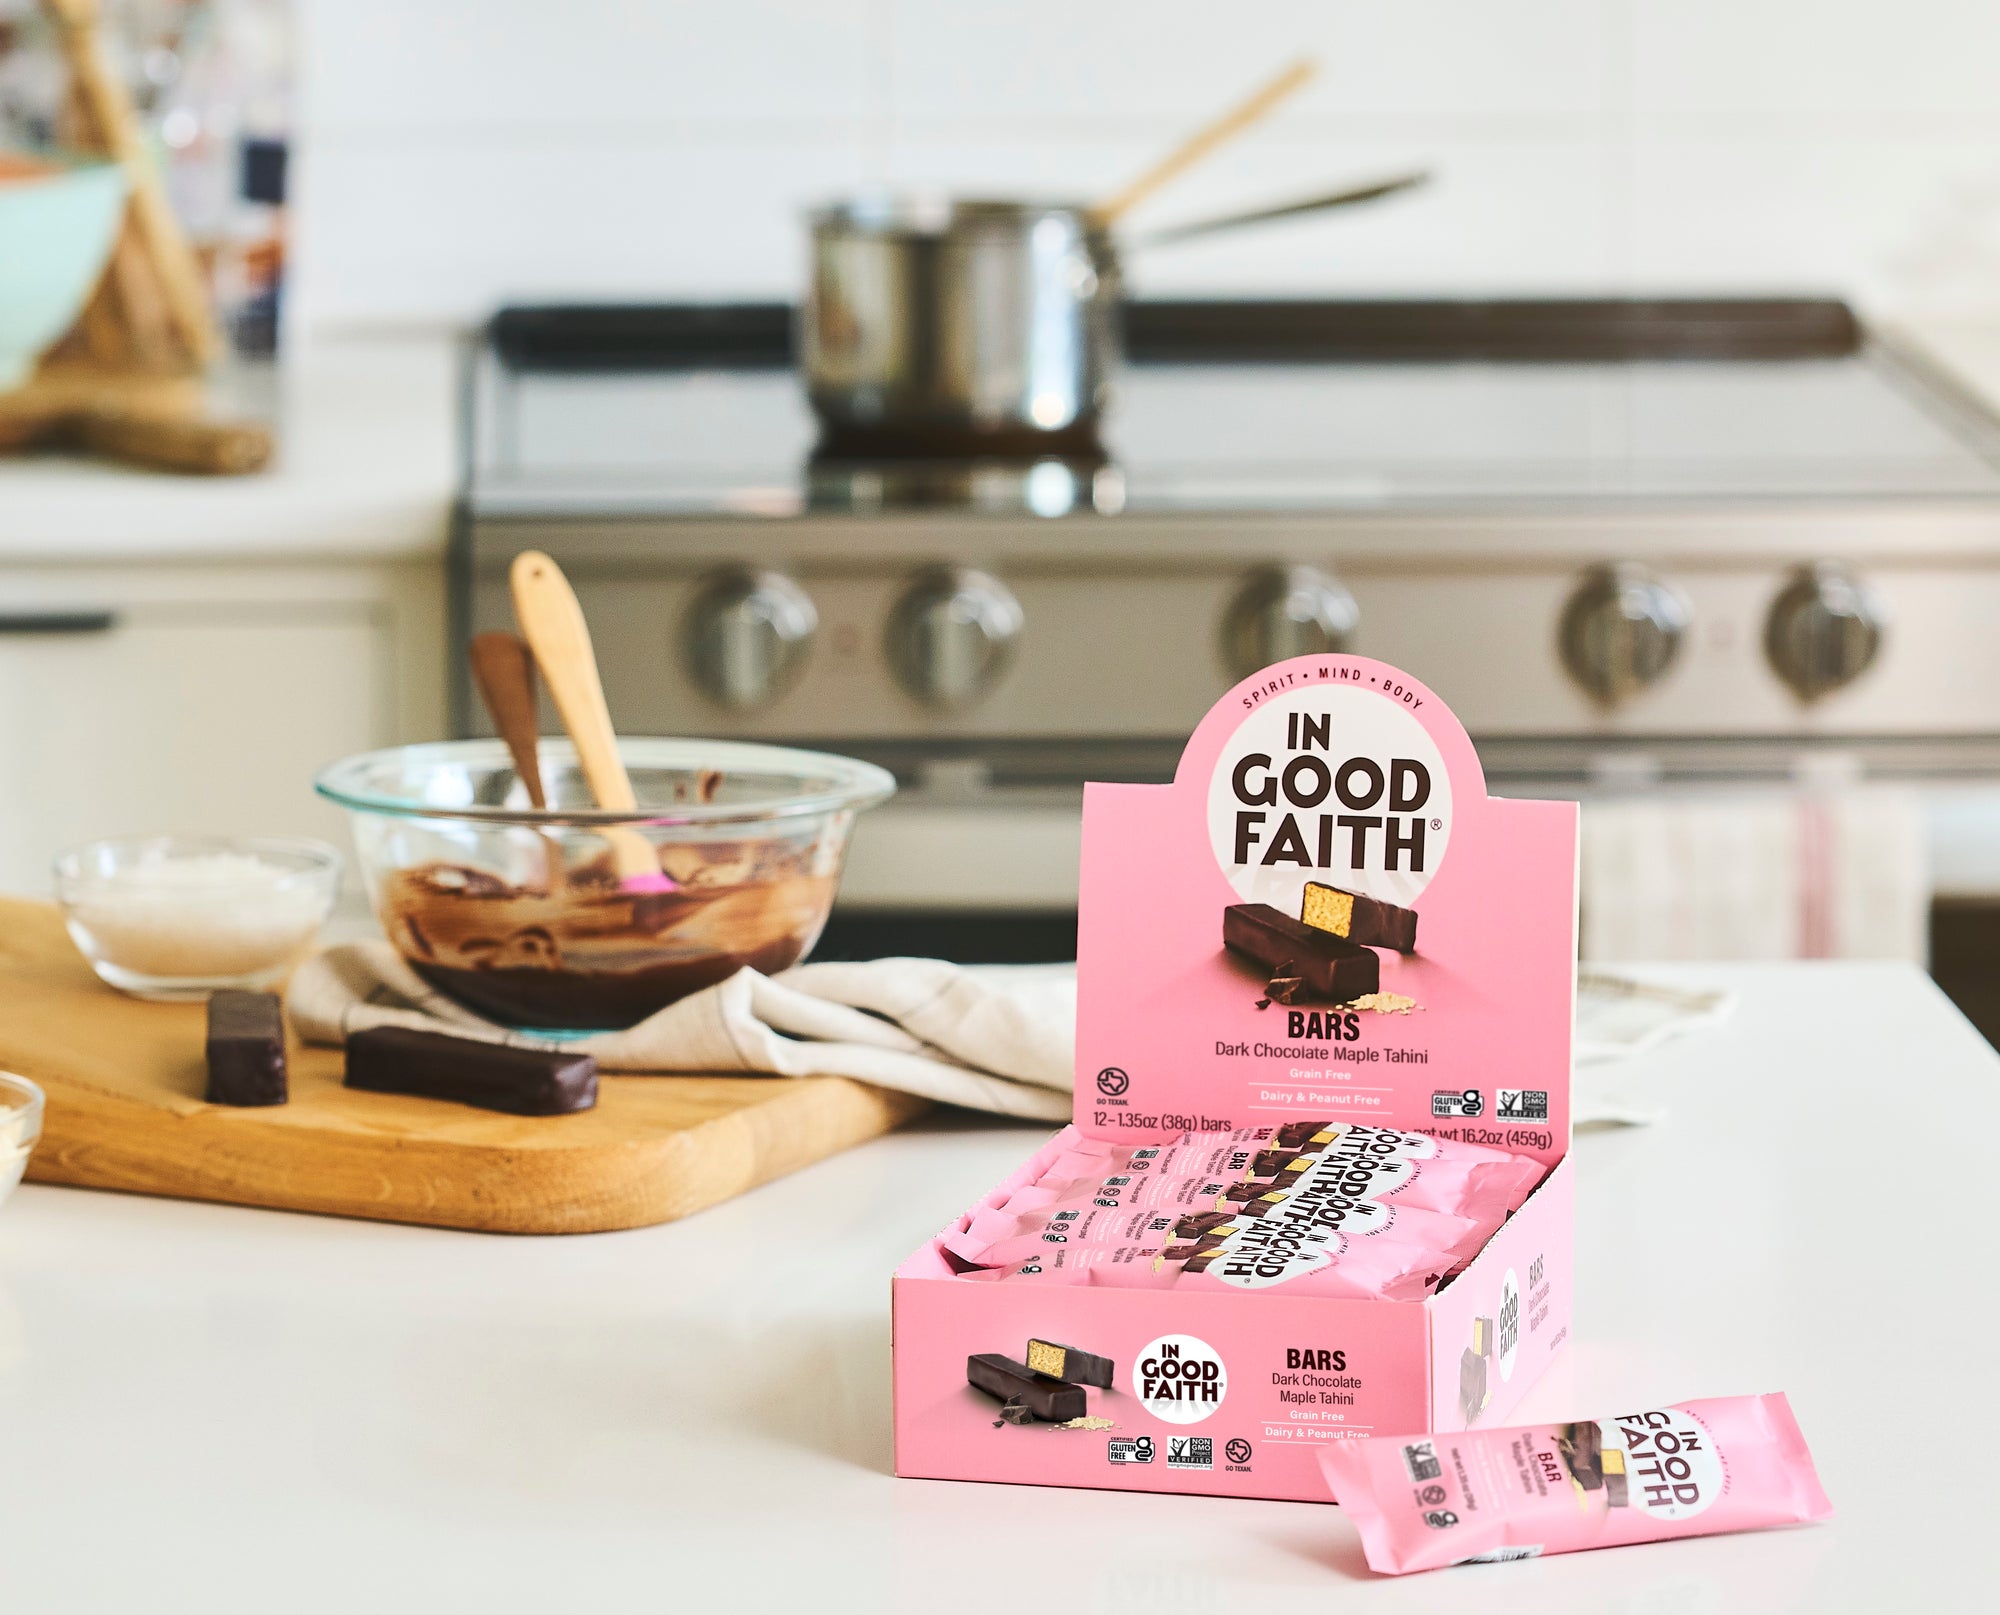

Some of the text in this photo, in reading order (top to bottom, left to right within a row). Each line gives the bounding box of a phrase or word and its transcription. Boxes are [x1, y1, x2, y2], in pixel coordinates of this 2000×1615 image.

[1243, 667, 1423, 710] SPIRIT MIND BODY
[1287, 712, 1331, 751] IN
[1232, 753, 1431, 812] GOOD
[1288, 1011, 1360, 1041] BARS
[1215, 1041, 1428, 1065] Dark Chocolate Maple Tahini
[1289, 1068, 1351, 1081] Grain Free
[1260, 1090, 1381, 1106] Dairy & Peanut Free
[1434, 1097, 1463, 1106] GLUTEN
[1434, 1105, 1451, 1113] FREE
[1499, 1110, 1546, 1118] VERIFIED
[1161, 1113, 1198, 1132] (38g)
[1201, 1115, 1232, 1132] bars
[1402, 1138, 1424, 1148] IN
[1439, 1129, 1459, 1141] wt
[1462, 1128, 1504, 1145] 16.2oz
[1506, 1129, 1553, 1150] (459g)
[1227, 1152, 1249, 1170] BAR
[1379, 1162, 1402, 1172] IN
[1353, 1203, 1378, 1216] IN
[1500, 1292, 1518, 1333] GOOD
[1500, 1317, 1518, 1360] FAITH
[1161, 1344, 1179, 1359] IN
[1286, 1348, 1347, 1372] BARS
[1141, 1358, 1219, 1381] GOOD
[1272, 1372, 1362, 1389] Dark Chocolate
[1143, 1379, 1218, 1402] FAITH
[1280, 1390, 1354, 1406] Maple Tahini
[1290, 1410, 1345, 1421] Grain Free
[1265, 1427, 1370, 1439] Dairy & Peanut Free
[1679, 1431, 1702, 1452] IN
[1110, 1443, 1136, 1452] GLUTEN
[1110, 1452, 1126, 1460] FREE
[1170, 1456, 1211, 1464] VERIFIED
[1644, 1411, 1699, 1505] GOOD
[1538, 1452, 1562, 1482] BAR
